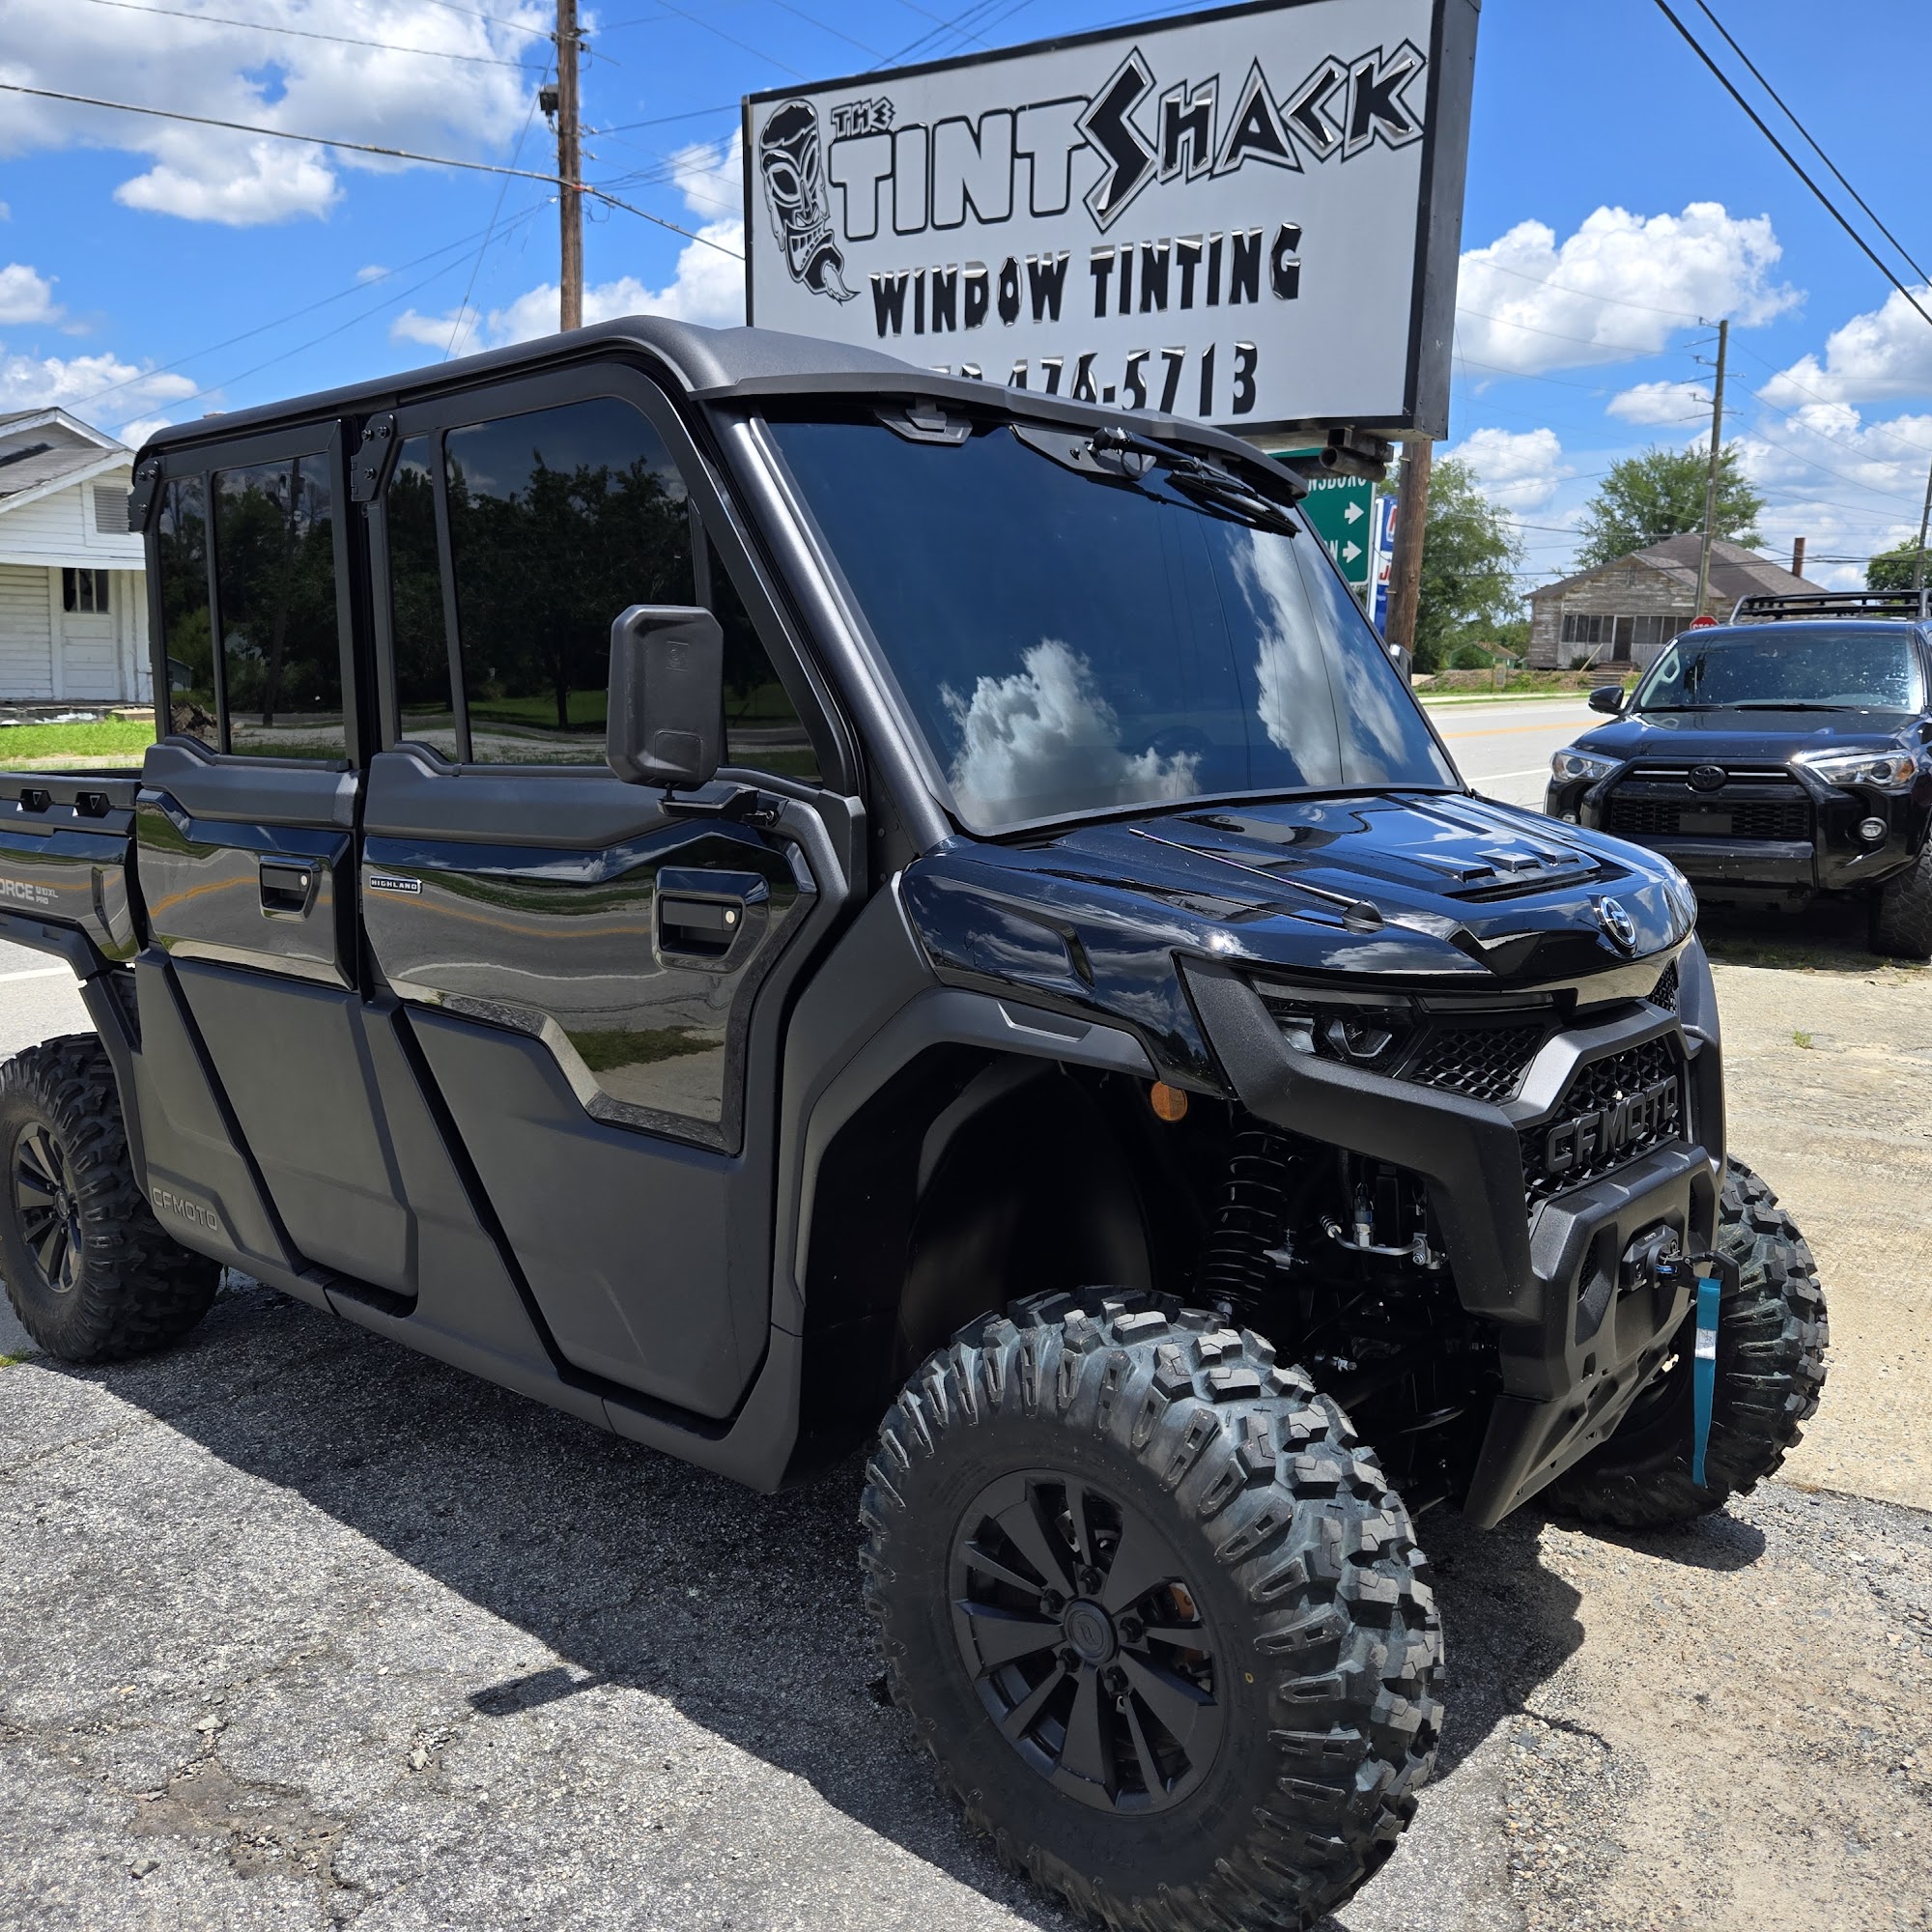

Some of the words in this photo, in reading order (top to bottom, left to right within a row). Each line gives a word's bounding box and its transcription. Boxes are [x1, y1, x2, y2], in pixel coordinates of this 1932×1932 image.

[831, 96, 896, 138] THE
[829, 94, 1090, 242] TINT
[1074, 38, 1428, 235] SHACK
[868, 249, 1071, 338] WINDOW
[1090, 222, 1303, 318] TINTING
[35, 895, 49, 905] PRO
[371, 879, 418, 890] HIGHLAND
[1547, 1074, 1679, 1174] CFMOTO
[152, 1187, 217, 1232] CFMOTO
